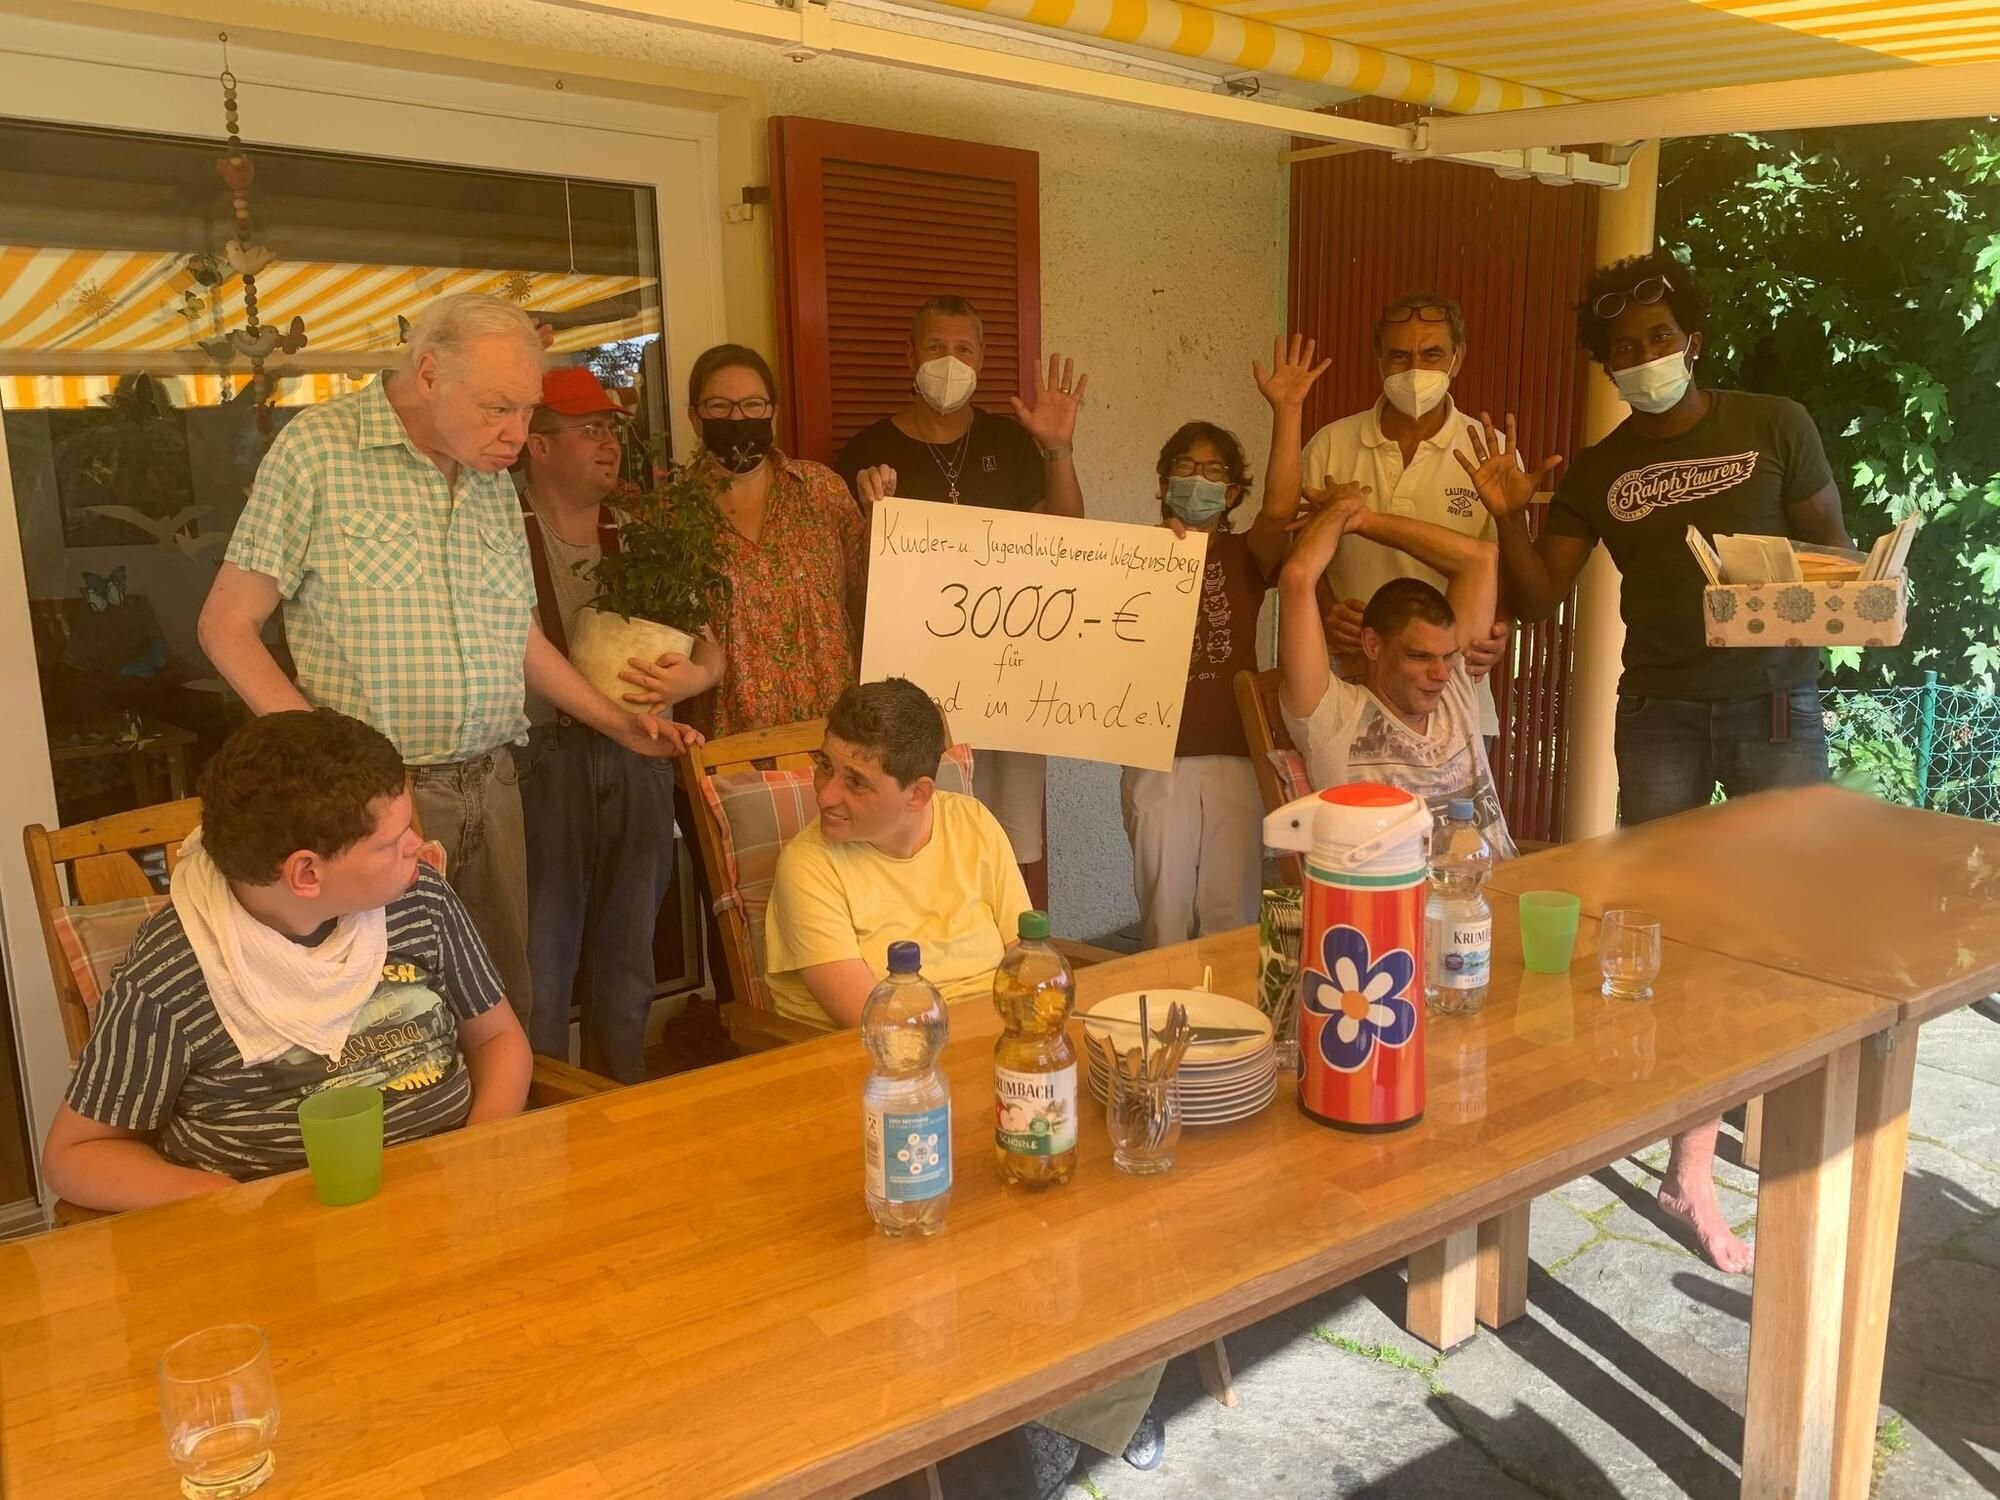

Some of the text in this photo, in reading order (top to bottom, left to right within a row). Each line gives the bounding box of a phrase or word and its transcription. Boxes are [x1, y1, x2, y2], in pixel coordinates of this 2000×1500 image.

[1619, 461, 1745, 510] Ralph Lauren
[1111, 591, 1152, 643] €
[993, 643, 1025, 684] für
[984, 694, 1009, 719] in
[1025, 679, 1128, 729] Hand
[993, 1076, 1054, 1100] RUMBACH
